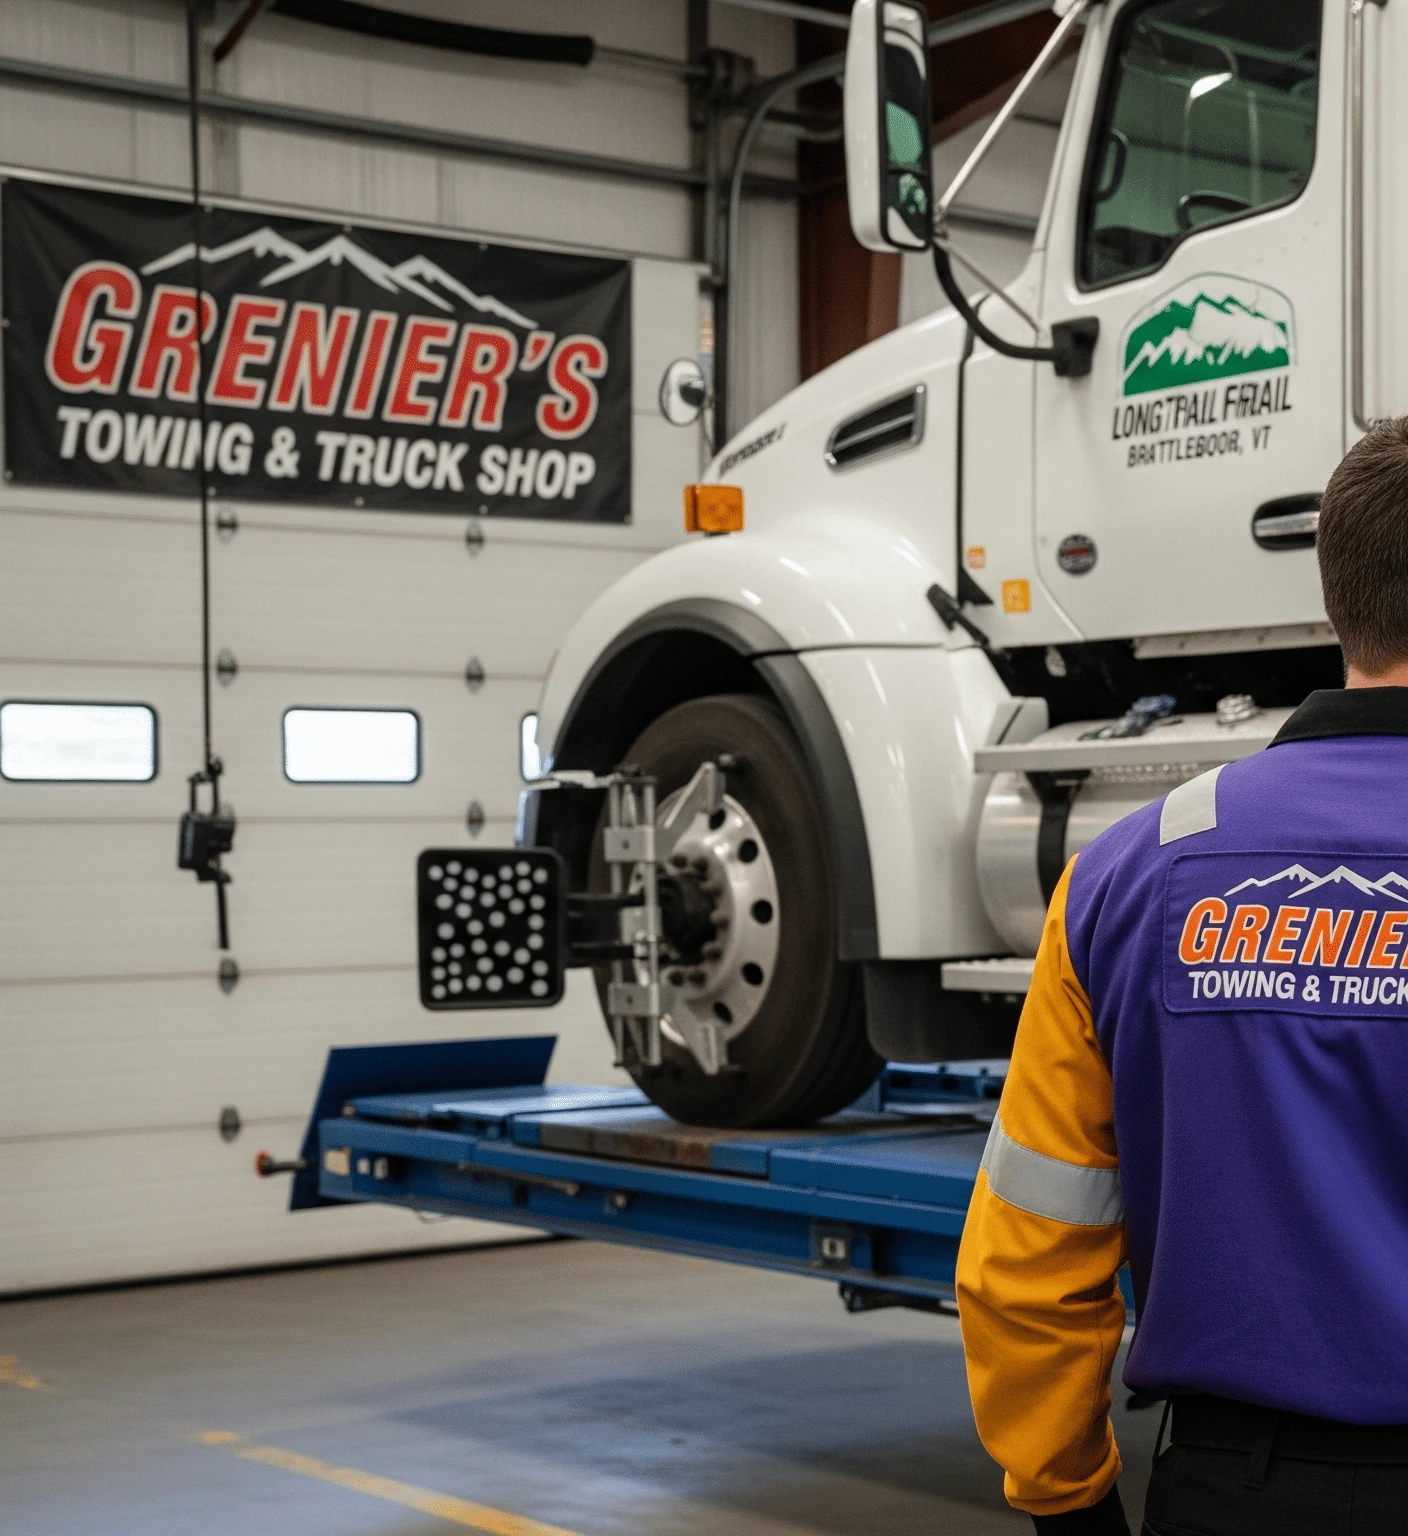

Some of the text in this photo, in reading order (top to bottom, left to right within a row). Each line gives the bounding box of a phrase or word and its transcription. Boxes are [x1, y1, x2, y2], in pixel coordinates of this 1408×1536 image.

[46, 263, 607, 438] GRENIER'S
[57, 407, 595, 500] TOWING & TRUCK SHOP
[1252, 424, 1272, 450] VT
[1188, 970, 1296, 1001] TOWING
[1301, 976, 1321, 1003] &
